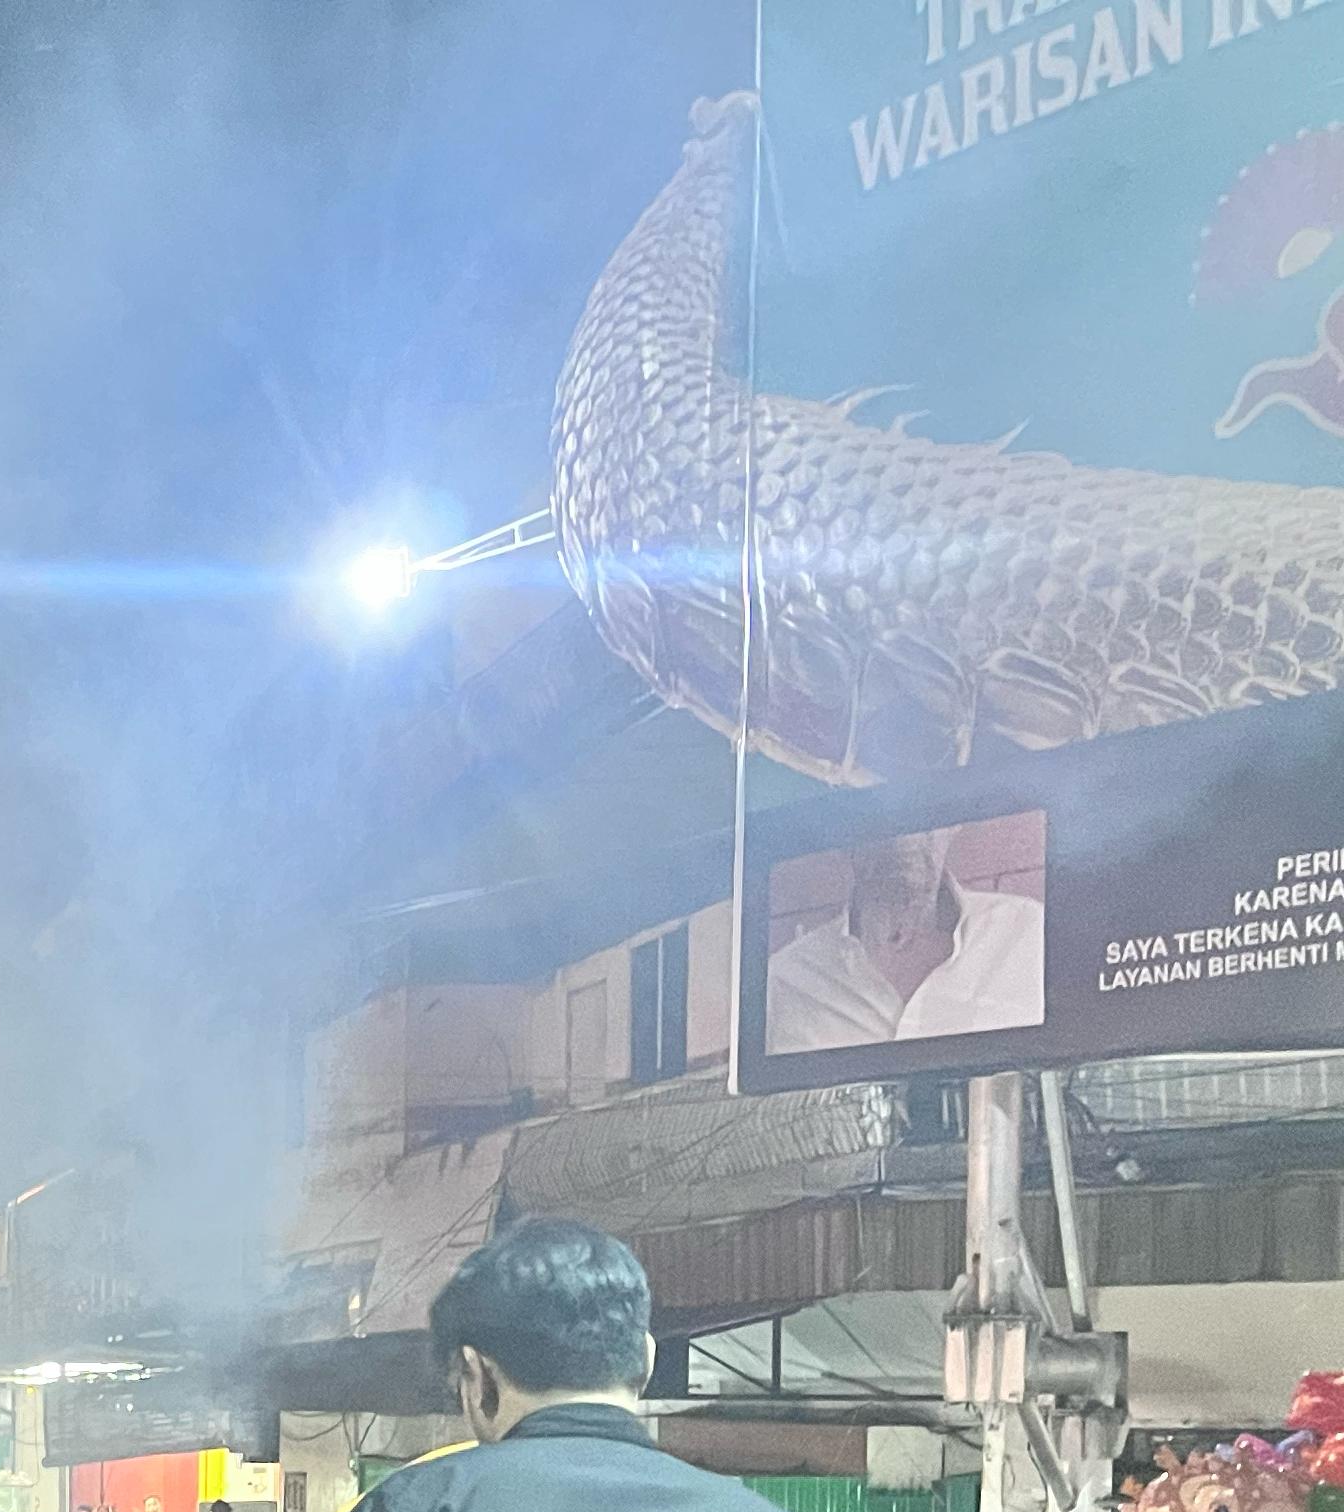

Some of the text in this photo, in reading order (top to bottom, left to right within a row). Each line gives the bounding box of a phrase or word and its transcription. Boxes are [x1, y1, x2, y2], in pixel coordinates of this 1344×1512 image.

[849, 0, 1184, 192] WARISAN
[1277, 848, 1344, 881] PERI
[1234, 877, 1344, 916] KARENA
[1105, 935, 1168, 965] SAYA
[1174, 917, 1299, 955] TERKENA
[1099, 959, 1201, 992] LAYANAN
[1208, 941, 1328, 979] BERHENTI
